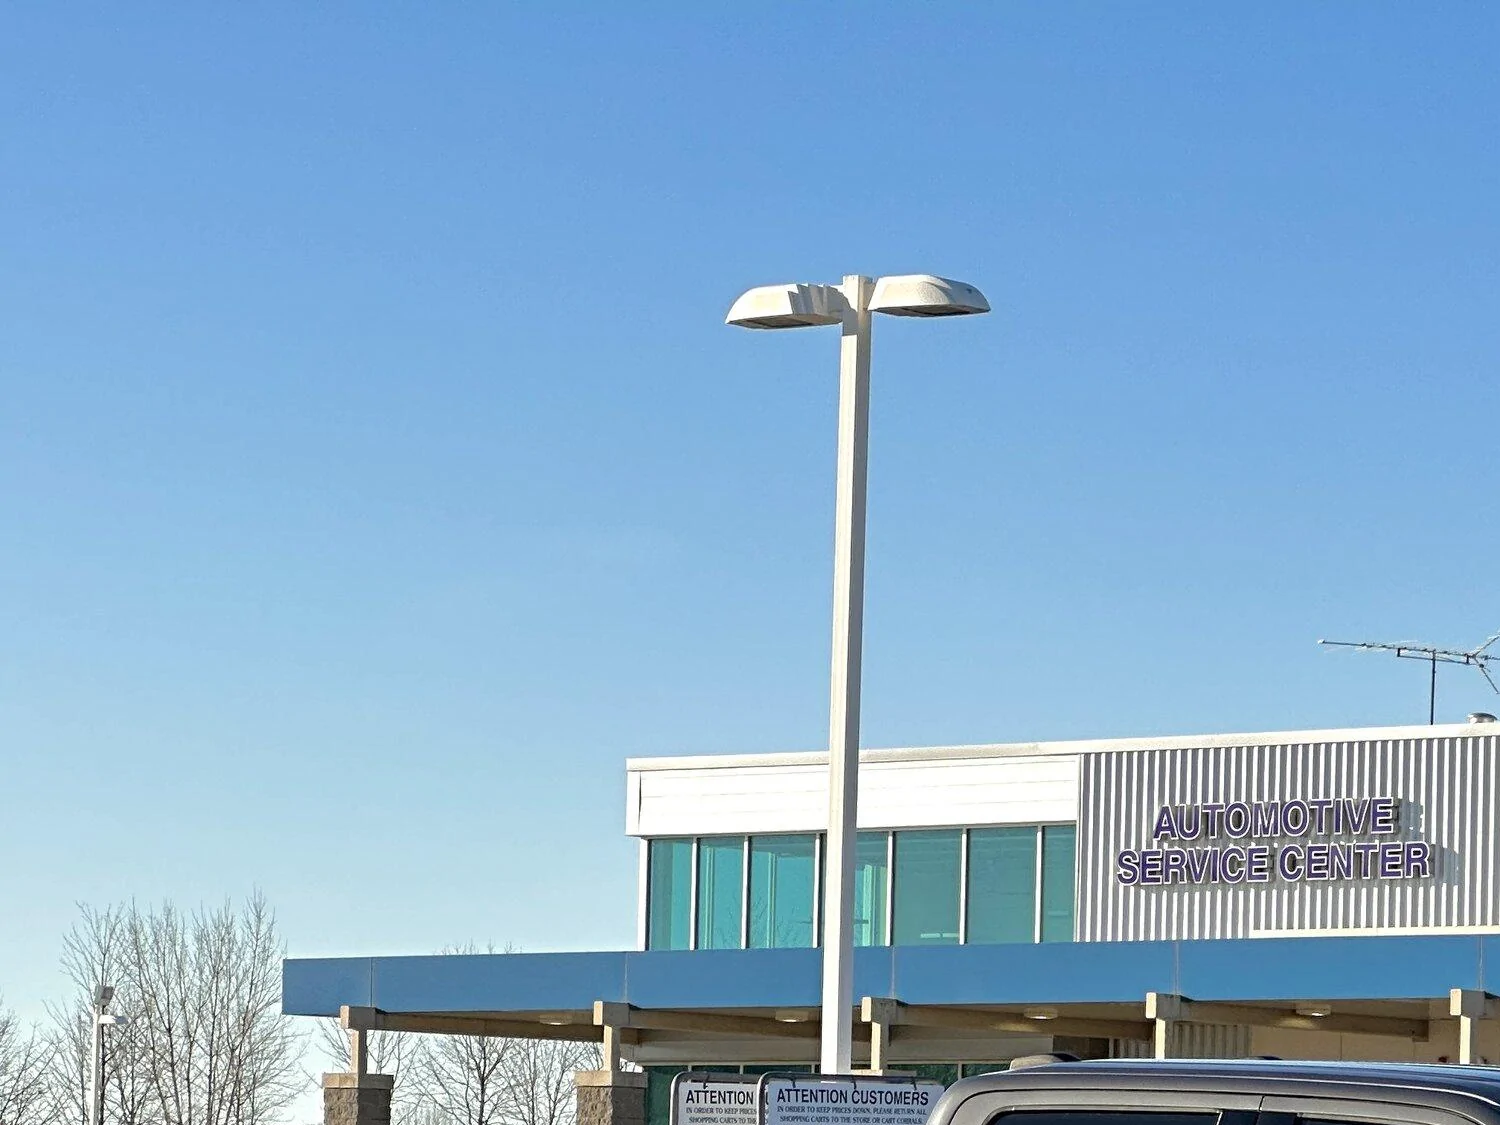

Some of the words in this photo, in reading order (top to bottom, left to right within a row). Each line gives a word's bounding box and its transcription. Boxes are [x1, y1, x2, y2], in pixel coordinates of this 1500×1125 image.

[1153, 797, 1395, 840] AUTOMOTIVE
[1117, 845, 1269, 886] SERVICE
[1279, 841, 1430, 882] CENTER
[686, 1090, 754, 1105] ATTENTION
[776, 1088, 848, 1104] ATTENTION
[851, 1090, 929, 1106] CUSTOMERS
